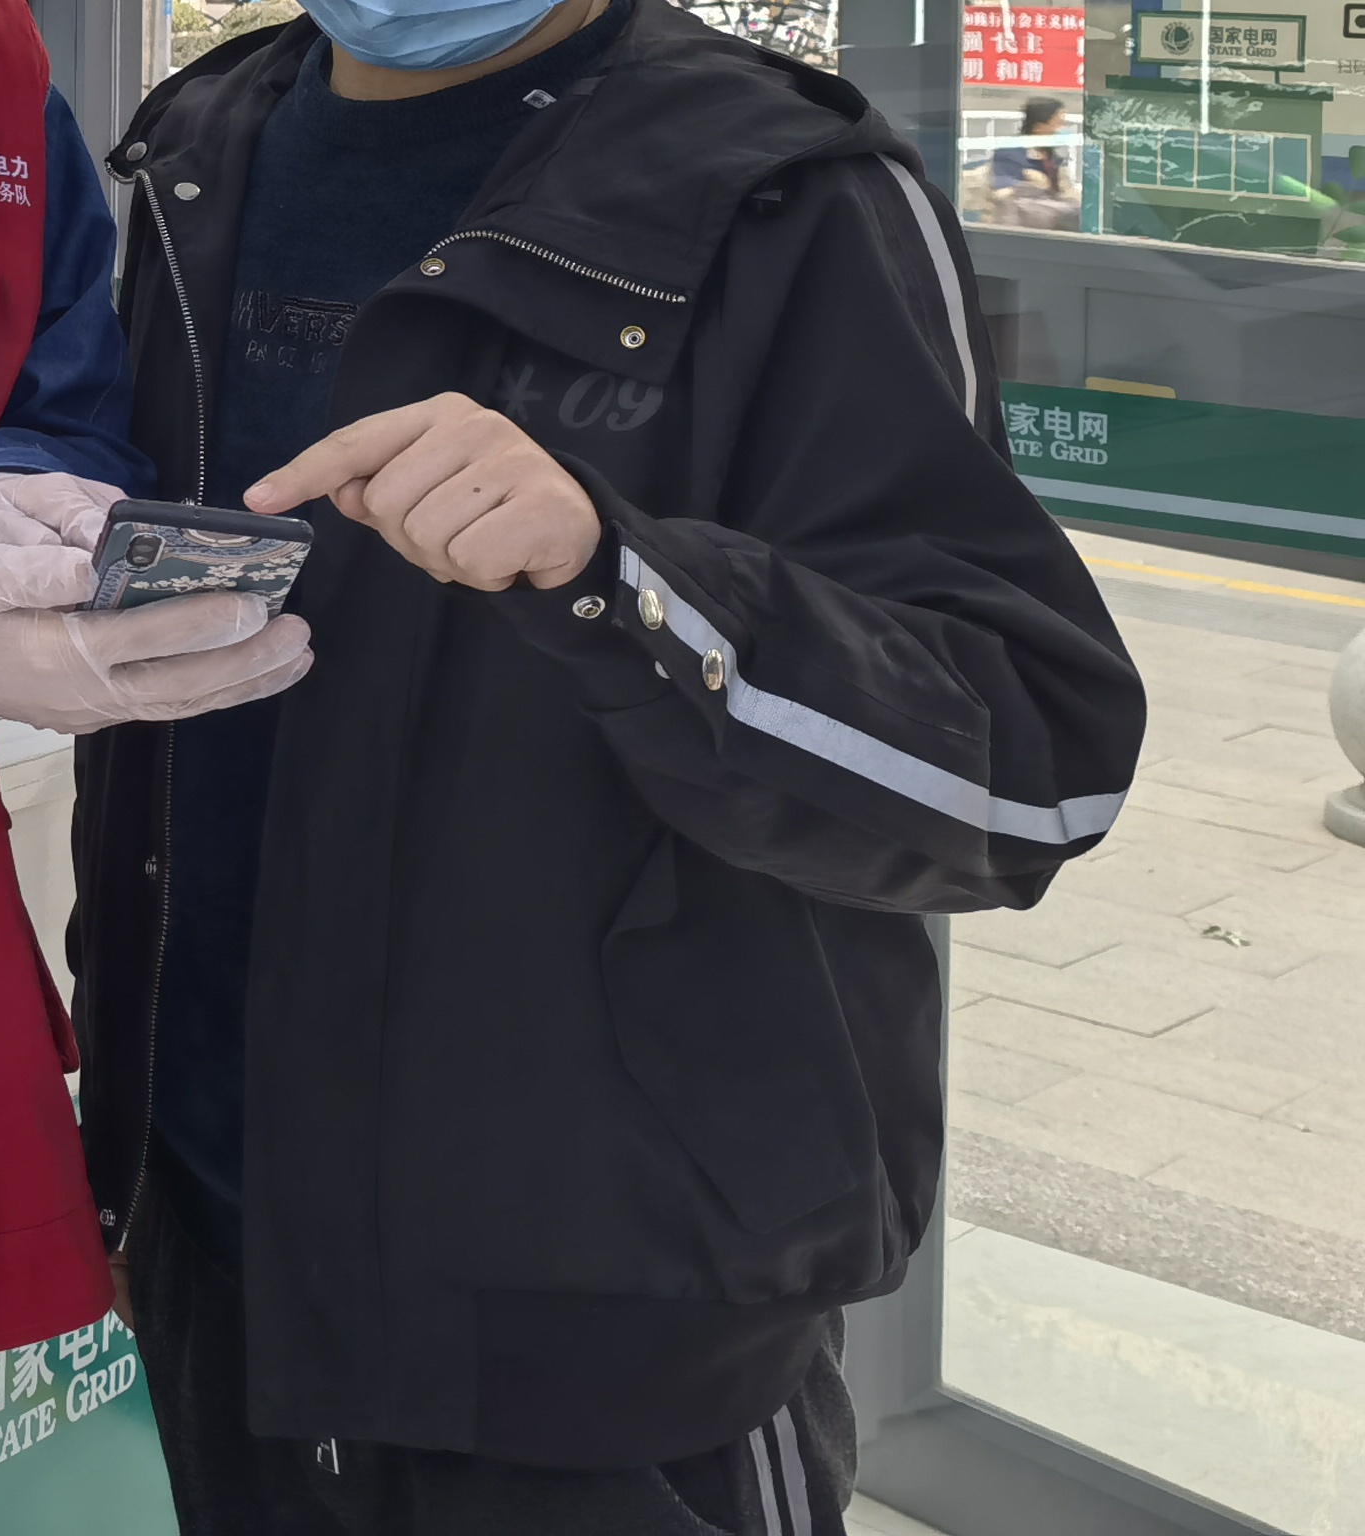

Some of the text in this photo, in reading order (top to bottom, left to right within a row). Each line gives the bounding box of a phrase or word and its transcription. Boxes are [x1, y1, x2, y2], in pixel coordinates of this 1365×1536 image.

[1246, 46, 1277, 58] GRID
[1000, 401, 1108, 445] 家电网
[1050, 440, 1108, 465] GRID
[65, 1353, 137, 1423] GRID
